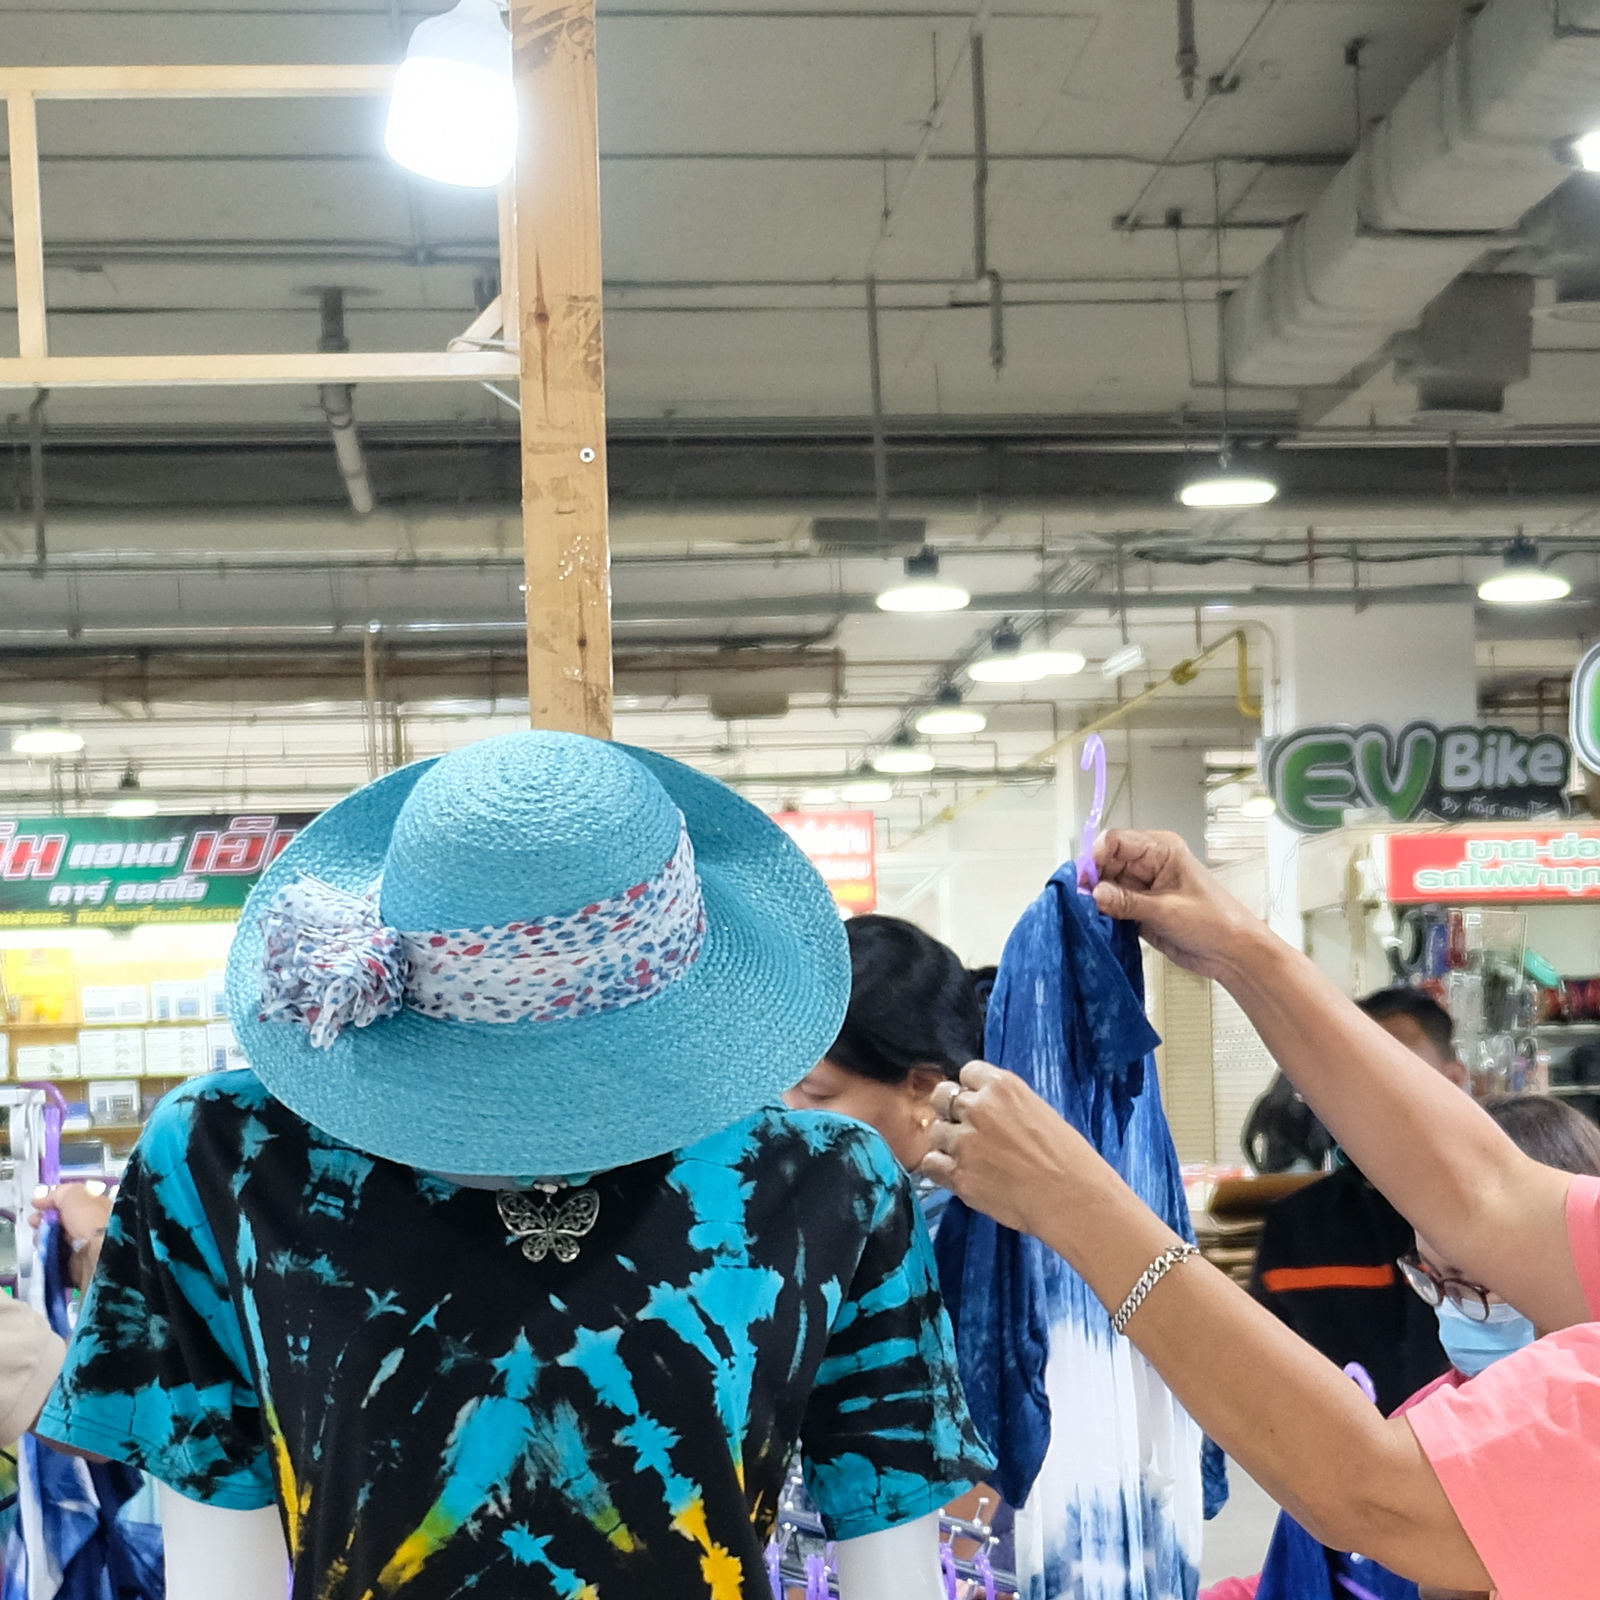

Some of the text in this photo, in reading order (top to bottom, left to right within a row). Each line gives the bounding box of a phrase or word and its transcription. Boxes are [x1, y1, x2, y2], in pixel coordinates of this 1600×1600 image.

[1278, 728, 1563, 831] EV Bike
[1441, 796, 1462, 814] By
[69, 836, 187, 869] แอนด์
[48, 874, 208, 905] คาร์ ออดิโอ
